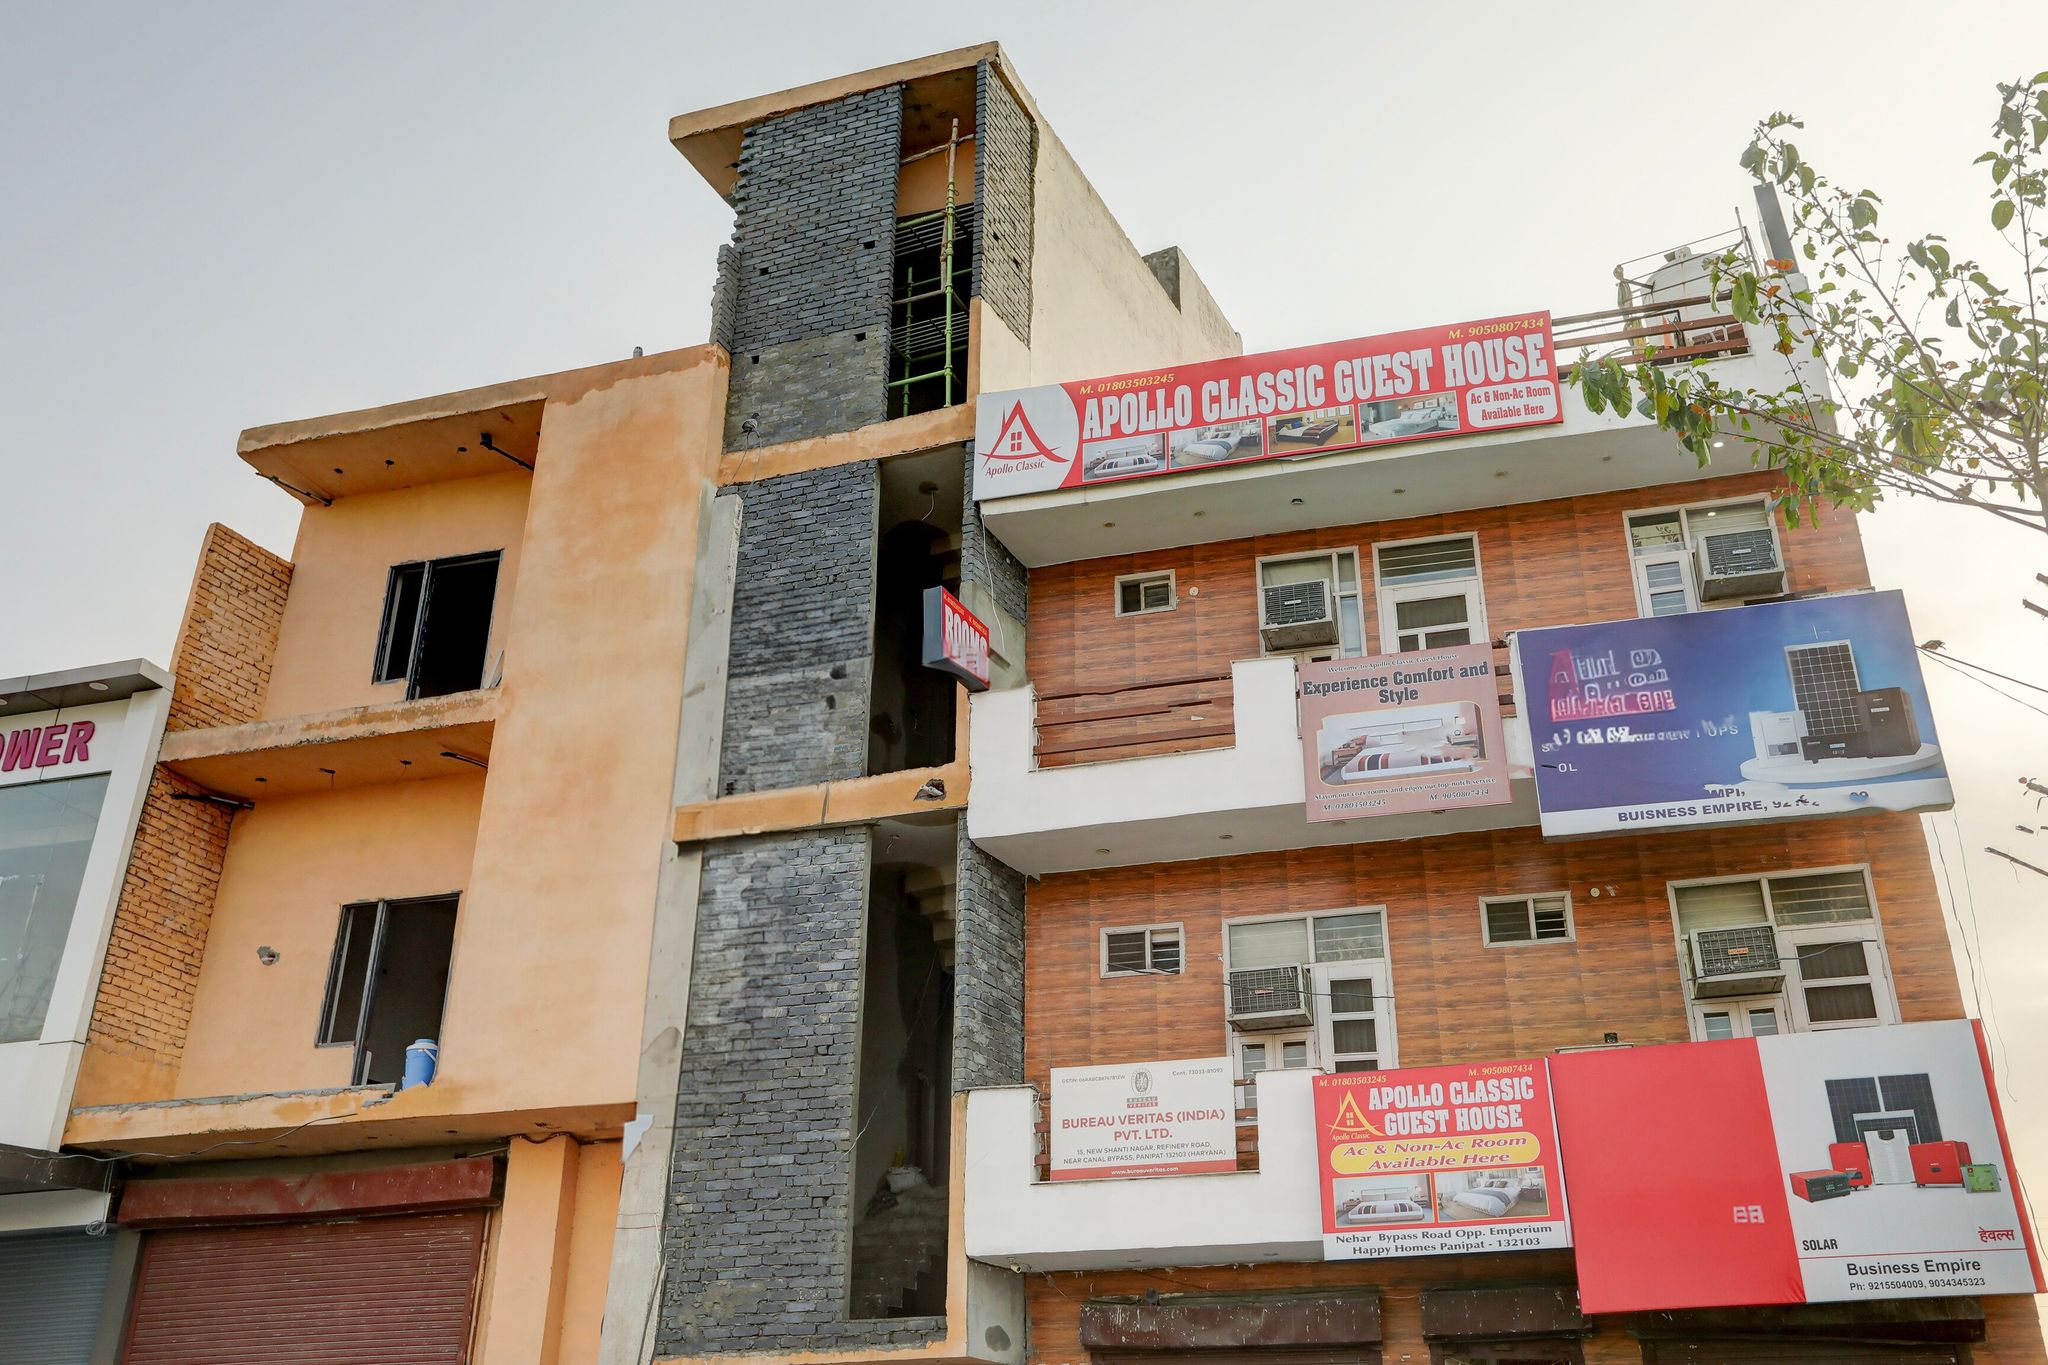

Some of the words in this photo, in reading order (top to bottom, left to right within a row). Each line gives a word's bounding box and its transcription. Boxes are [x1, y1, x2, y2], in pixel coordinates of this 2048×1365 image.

[1448, 328, 1464, 339] M.
[1468, 317, 1545, 337] 9050807434
[1080, 385, 1094, 395] M.
[1098, 374, 1175, 392] 01803503245
[1083, 384, 1193, 440] APOLLO
[1202, 364, 1326, 423] CLASSIC
[1333, 347, 1433, 403] GUEST
[1441, 333, 1549, 388] HOUSE
[1471, 393, 1482, 404] Ac
[1484, 391, 1491, 402] &
[1492, 388, 1523, 401] Non-Ac
[1526, 385, 1551, 397] Room
[1481, 405, 1521, 421] Available
[1523, 404, 1544, 415] Here
[985, 462, 1013, 478] Apollo
[1015, 458, 1045, 472] Classic
[1303, 676, 1388, 697] Experience
[1393, 668, 1454, 686] Comfort
[1459, 661, 1489, 678] and
[1379, 687, 1419, 705] Style
[1617, 806, 1697, 822] BUISNESS
[1702, 800, 1768, 815] EMPIRE,
[1468, 1068, 1480, 1077] M.
[1481, 1064, 1533, 1075] 9050807434
[1319, 1078, 1330, 1087] M.
[1331, 1075, 1387, 1086] 01803503245
[1368, 1083, 1444, 1111] APOLLO
[1449, 1076, 1535, 1106] CLASSIC
[1062, 1115, 1115, 1129] BUREAU
[1118, 1111, 1173, 1125] VERITAS
[1176, 1108, 1225, 1124] (INDIA)
[1384, 1109, 1450, 1137] GUEST
[1455, 1104, 1524, 1132] HOUSE
[1114, 1129, 1142, 1142] PVT.
[1145, 1127, 1173, 1140] LTD.
[1332, 1133, 1350, 1142] Apollo
[1351, 1131, 1370, 1140] Classic
[1086, 1147, 1103, 1155] NEW
[1103, 1145, 1129, 1153] SHANTI
[1130, 1144, 1155, 1152] NAGAR,
[1156, 1142, 1189, 1150] REFINERY
[1190, 1141, 1212, 1149] ROAD,
[1343, 1147, 1367, 1157] Ac
[1373, 1145, 1387, 1155] &
[1394, 1140, 1465, 1154] Non-Ac
[1471, 1136, 1527, 1149] Room
[1063, 1157, 1082, 1165] NEAR
[1083, 1155, 1106, 1163] CANAL
[1107, 1154, 1135, 1163] BYPASS,
[1187, 1149, 1226, 1157] (HARYANA)
[1369, 1150, 1457, 1171] Available
[1463, 1152, 1510, 1164] Here
[1111, 1165, 1179, 1175] www.bureauveritas.com
[1336, 1234, 1372, 1244] Nehar
[1378, 1231, 1418, 1244] Bypass
[1421, 1229, 1452, 1240] Road
[1455, 1227, 1486, 1240] Opp.
[1489, 1224, 1552, 1238] Emperium
[1978, 1226, 2015, 1243] हेवल्स
[1352, 1245, 1391, 1258] Happy
[1394, 1242, 1436, 1254] Homes
[1439, 1239, 1485, 1253] Panipat
[1497, 1236, 1541, 1248] 132103
[1802, 1238, 1838, 1251] SOLAR
[1846, 1261, 1920, 1277] Business
[1924, 1258, 1981, 1275] Empire
[1850, 1282, 1866, 1291] Ph:
[1868, 1279, 1927, 1291] 9215504009,
[1928, 1277, 1986, 1289] 9034345323
